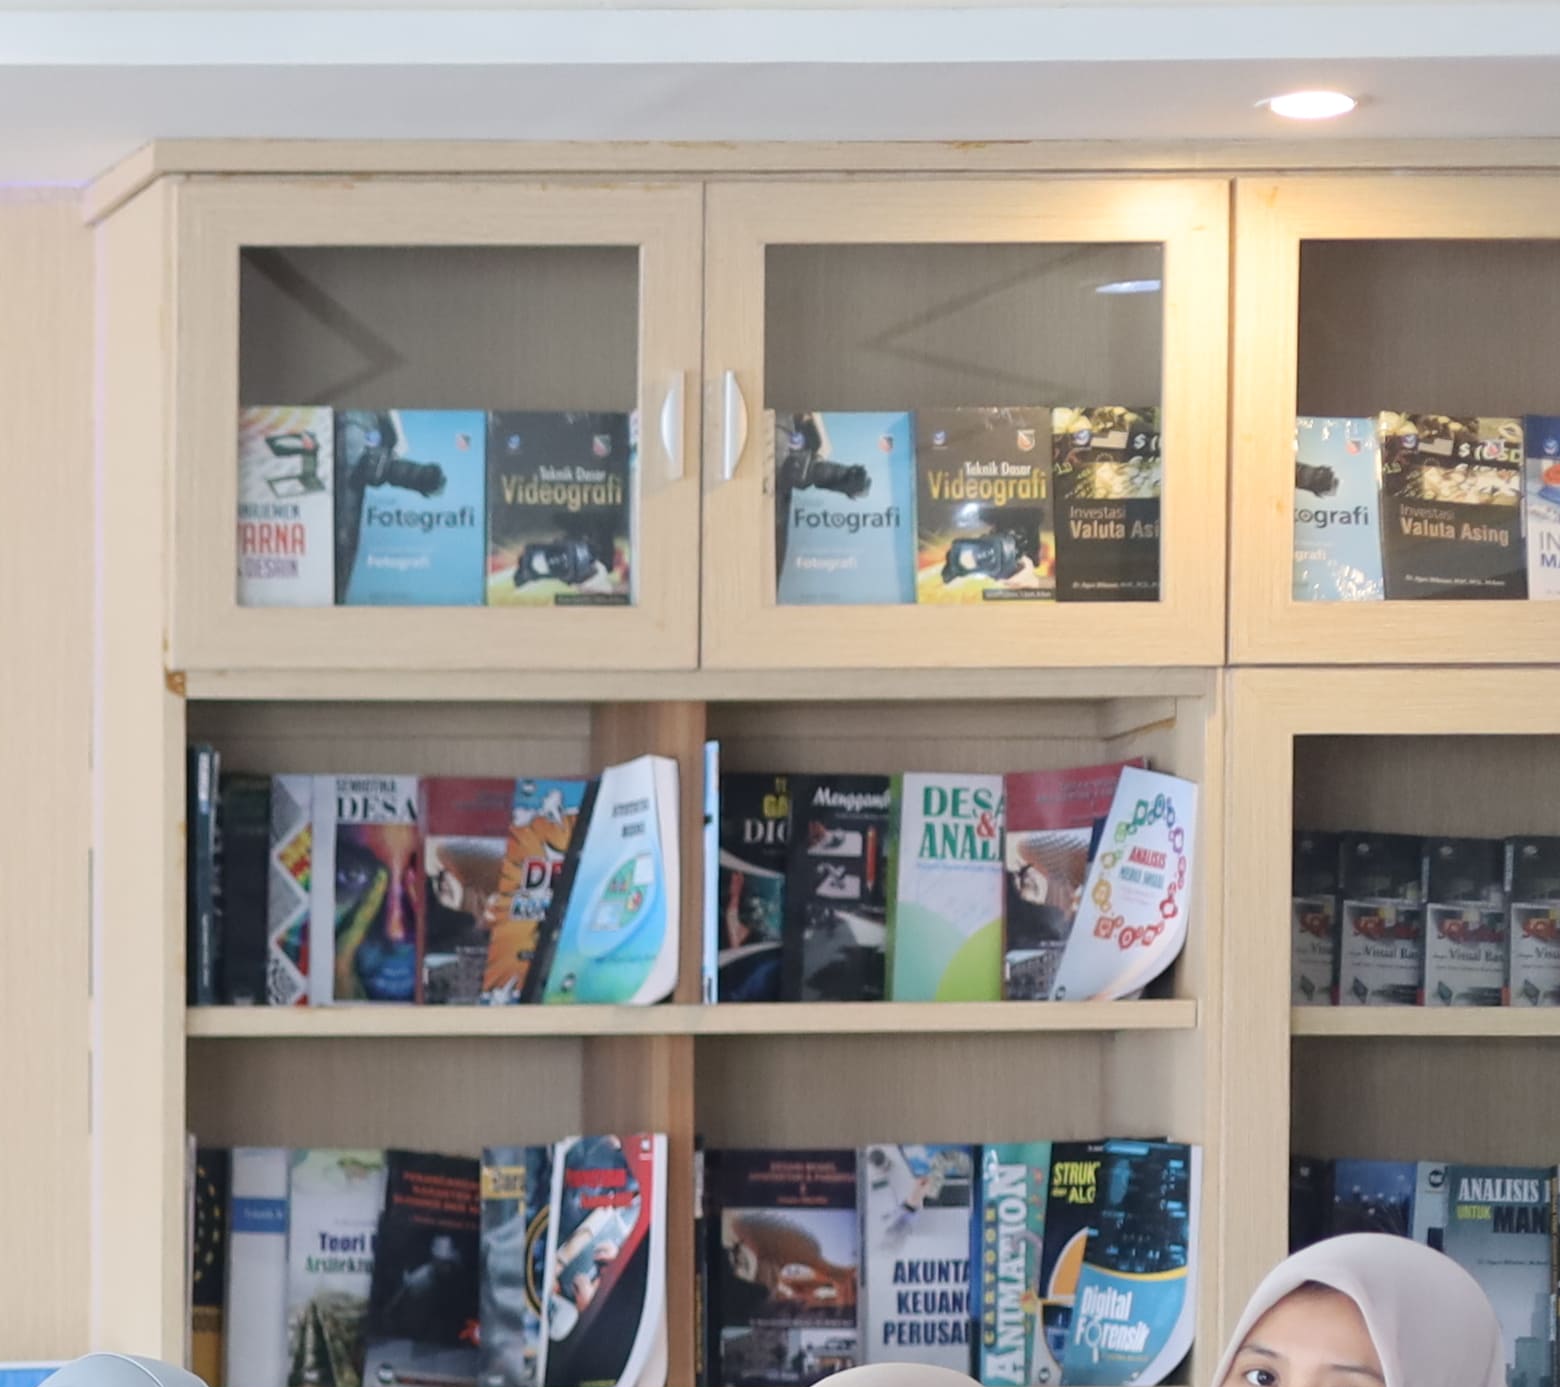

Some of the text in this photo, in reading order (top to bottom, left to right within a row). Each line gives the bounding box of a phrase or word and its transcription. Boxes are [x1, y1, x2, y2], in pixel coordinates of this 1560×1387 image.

[965, 461, 1032, 476] Teknik Dasar
[501, 475, 622, 510] Videografi
[927, 470, 1048, 504] Videografi
[366, 507, 476, 532] Fotografi
[794, 506, 901, 533] Fotografi
[1070, 521, 1126, 539] Valuta
[1400, 518, 1510, 546] Valuta Asing
[1457, 1177, 1540, 1203] ANALISIS
[1081, 1285, 1133, 1320] Digital
